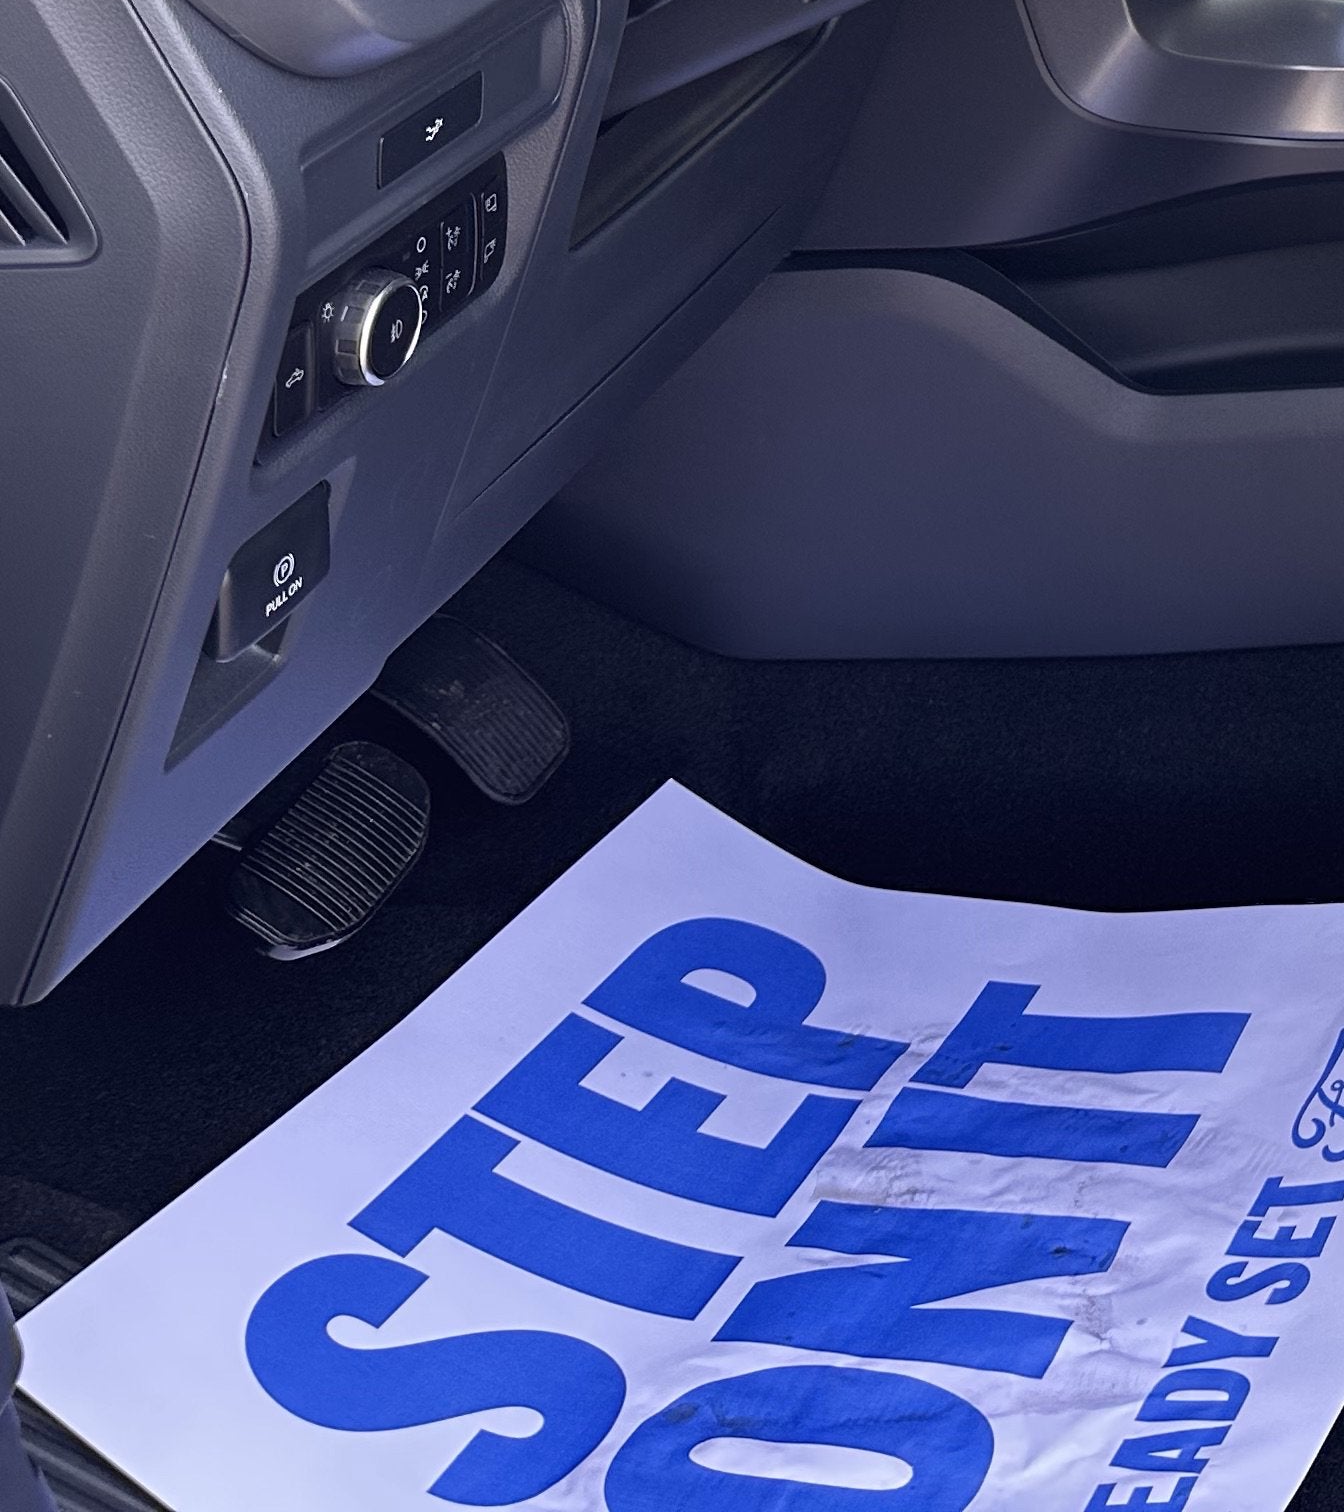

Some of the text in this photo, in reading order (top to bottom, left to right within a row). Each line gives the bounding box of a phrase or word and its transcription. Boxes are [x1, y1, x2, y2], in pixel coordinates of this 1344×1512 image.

[265, 577, 303, 617] PULL ON
[245, 917, 911, 1506] STEP
[604, 980, 1252, 1512] ON IT
[1083, 1315, 1280, 1512] EADY
